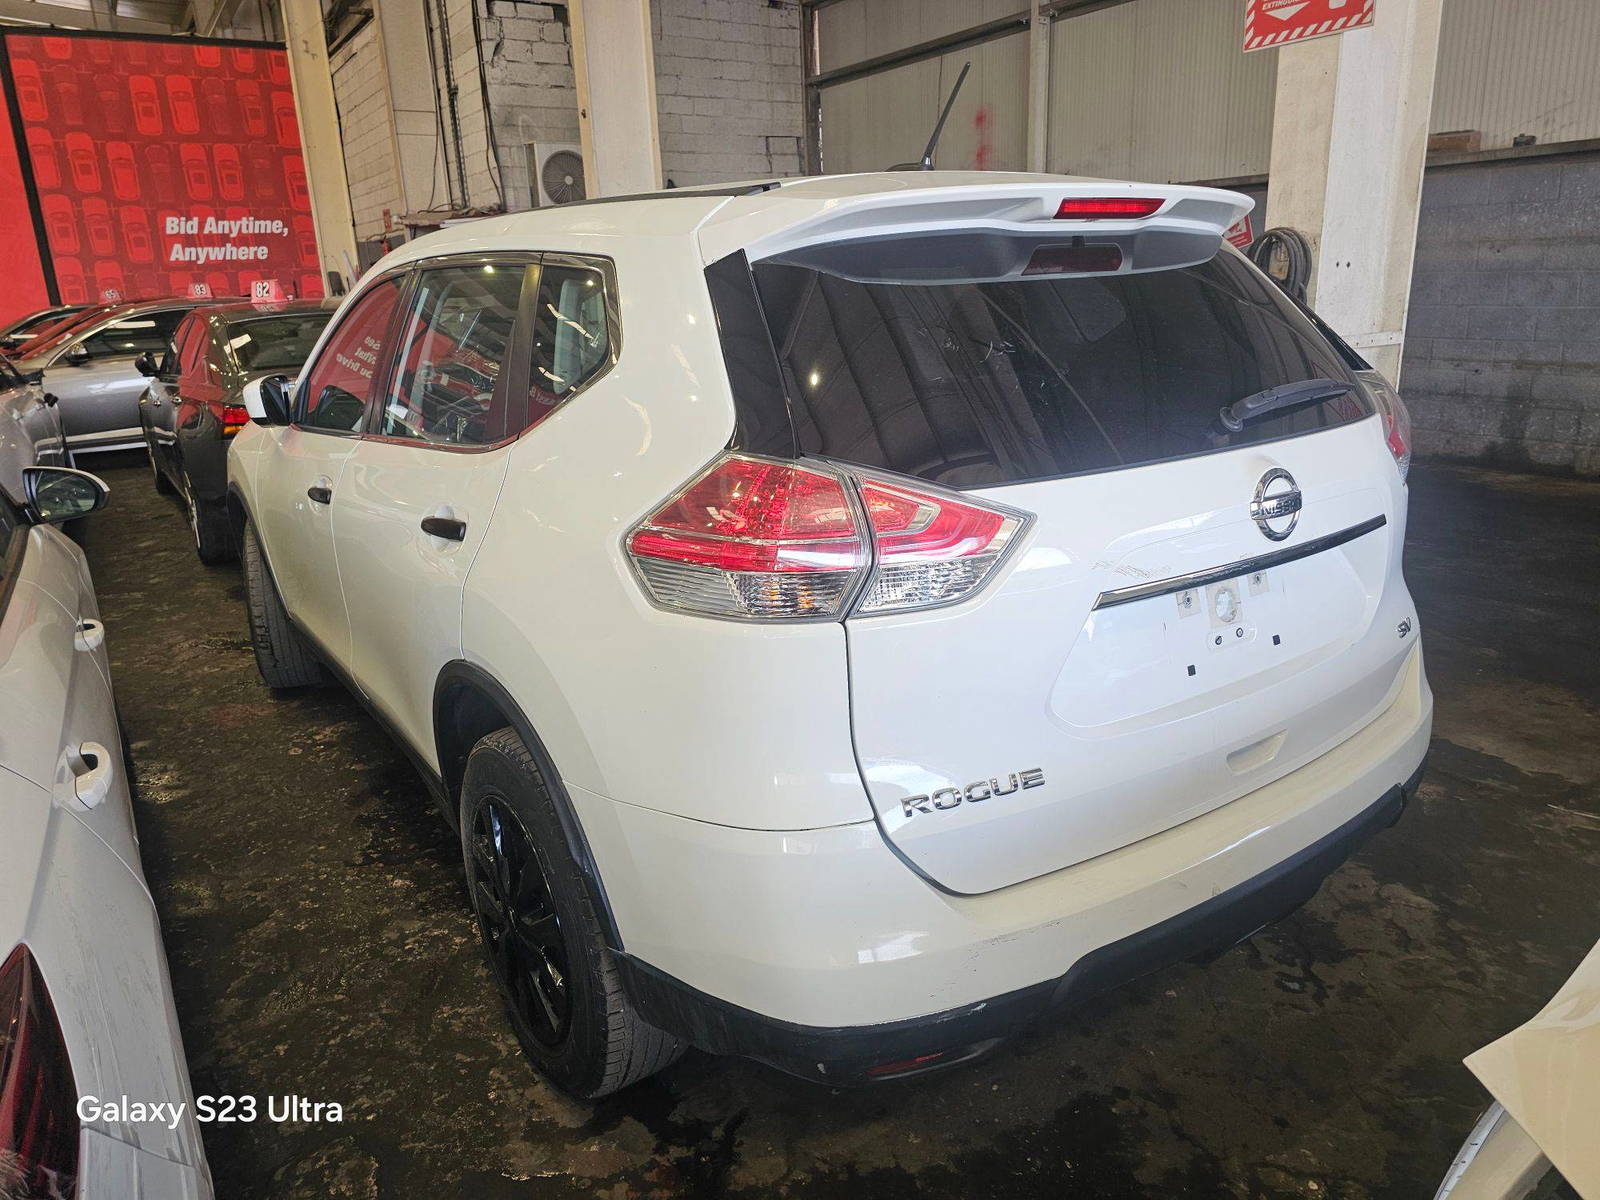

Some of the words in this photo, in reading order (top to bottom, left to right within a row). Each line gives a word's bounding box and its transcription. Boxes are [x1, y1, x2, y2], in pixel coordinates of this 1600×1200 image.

[166, 216, 199, 235] Bid
[203, 216, 289, 238] Anytime,
[170, 243, 269, 264] Anywhere
[194, 284, 207, 295] 83
[256, 281, 270, 298] 82
[900, 767, 1046, 817] ROGUE
